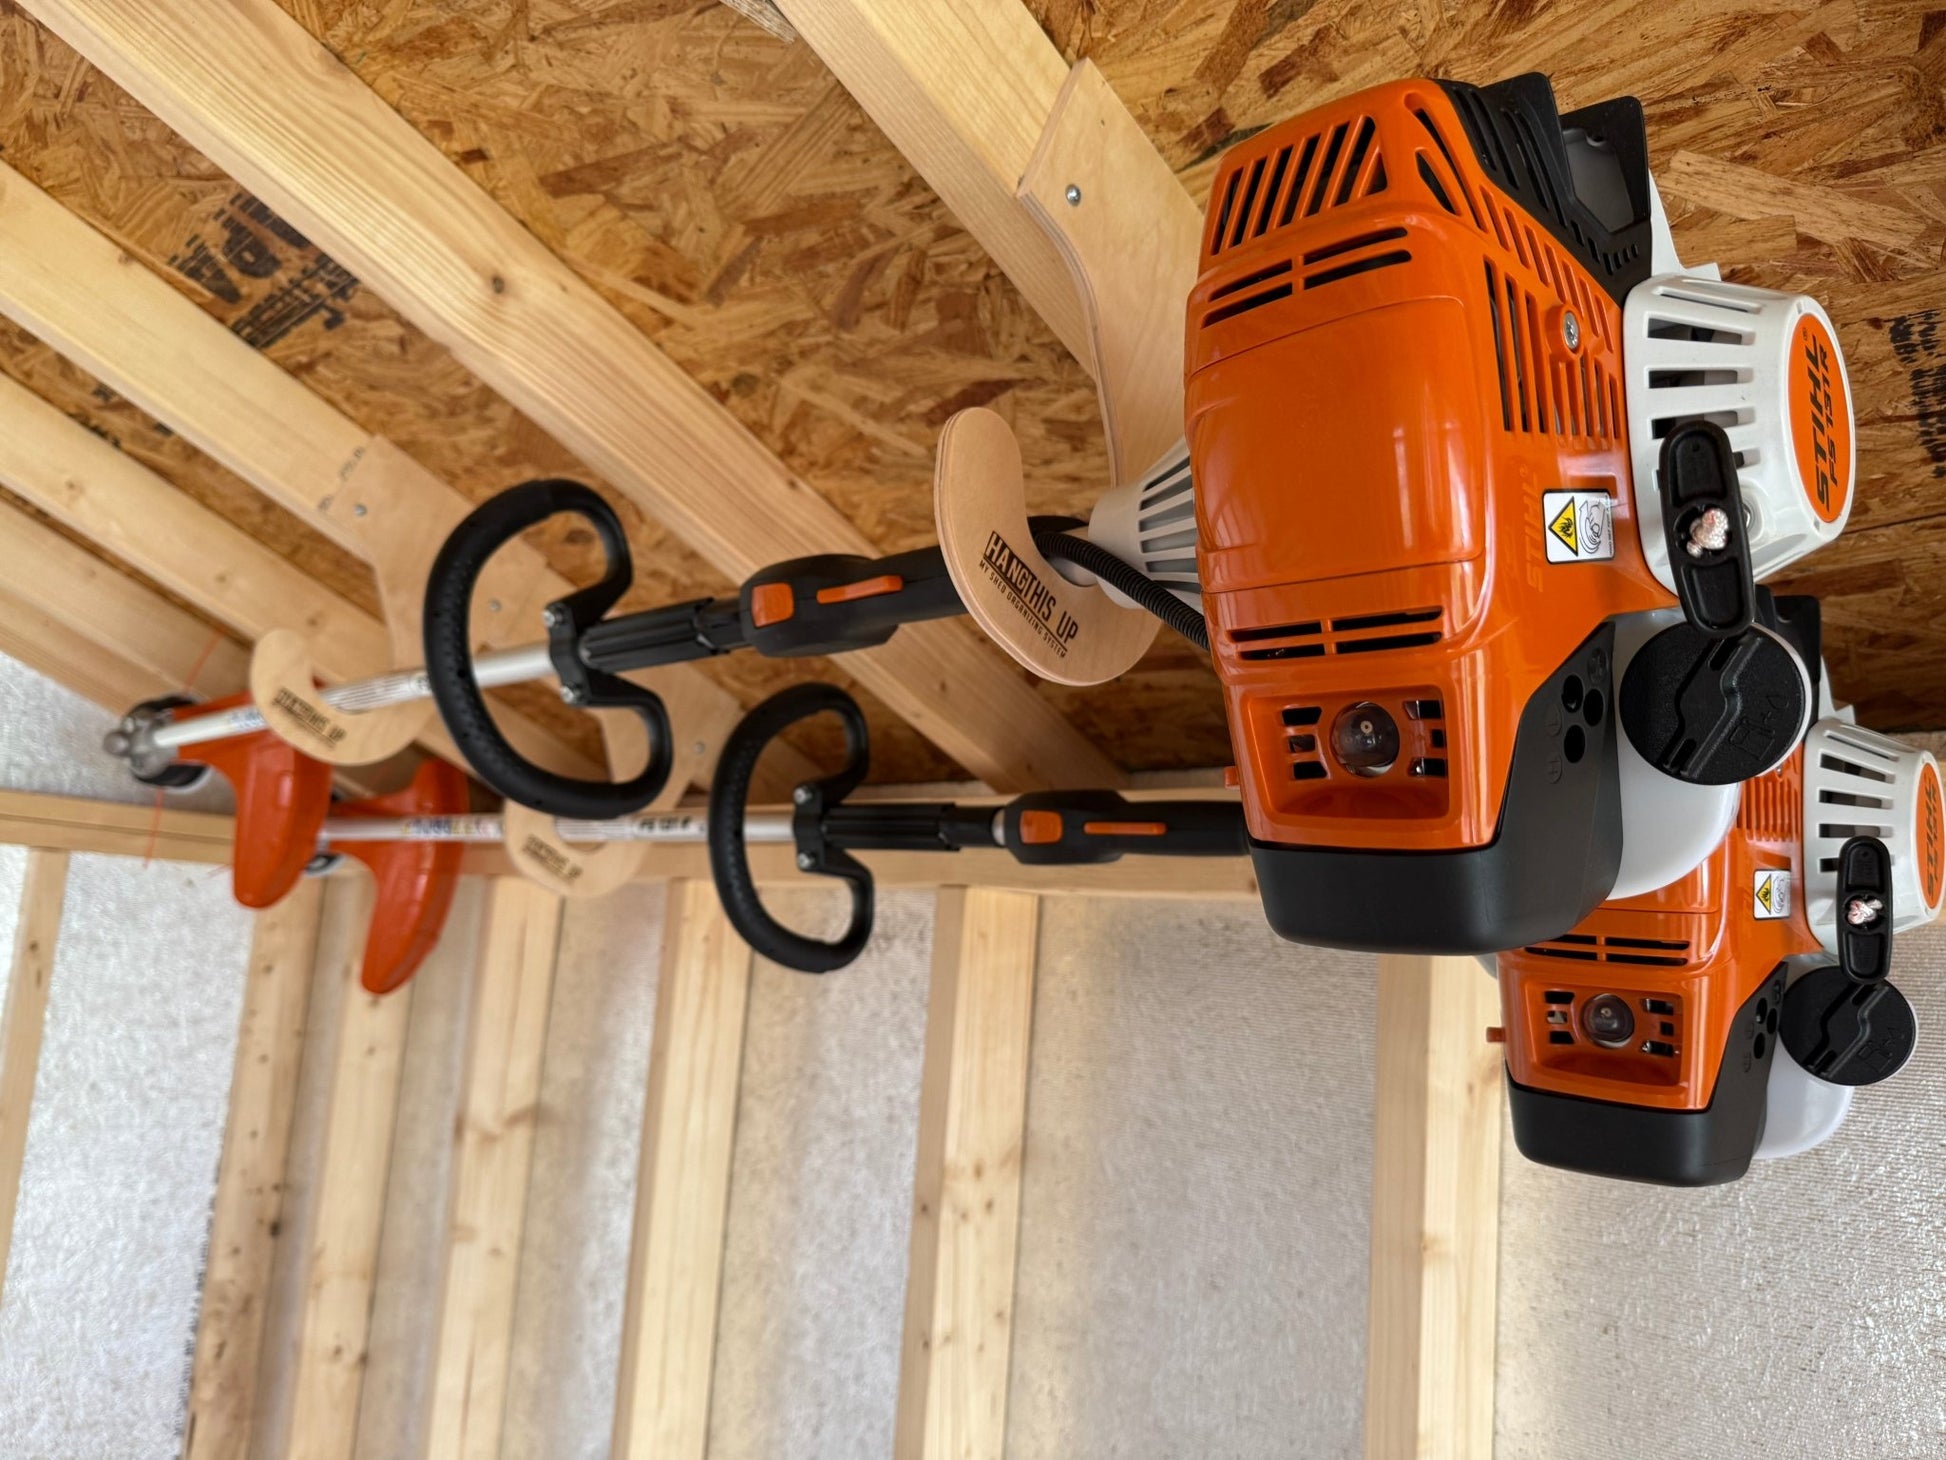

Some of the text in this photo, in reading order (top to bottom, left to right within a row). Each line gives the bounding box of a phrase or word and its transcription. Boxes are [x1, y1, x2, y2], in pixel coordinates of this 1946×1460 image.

[1805, 334, 1829, 512] STIHL
[1827, 436, 1838, 487] FS
[1521, 472, 1543, 592] STIHL
[979, 559, 1067, 658] MY SHED ORGANIZING SYSTEM
[1056, 611, 1078, 644] UP
[1924, 778, 1934, 901] STIHL
